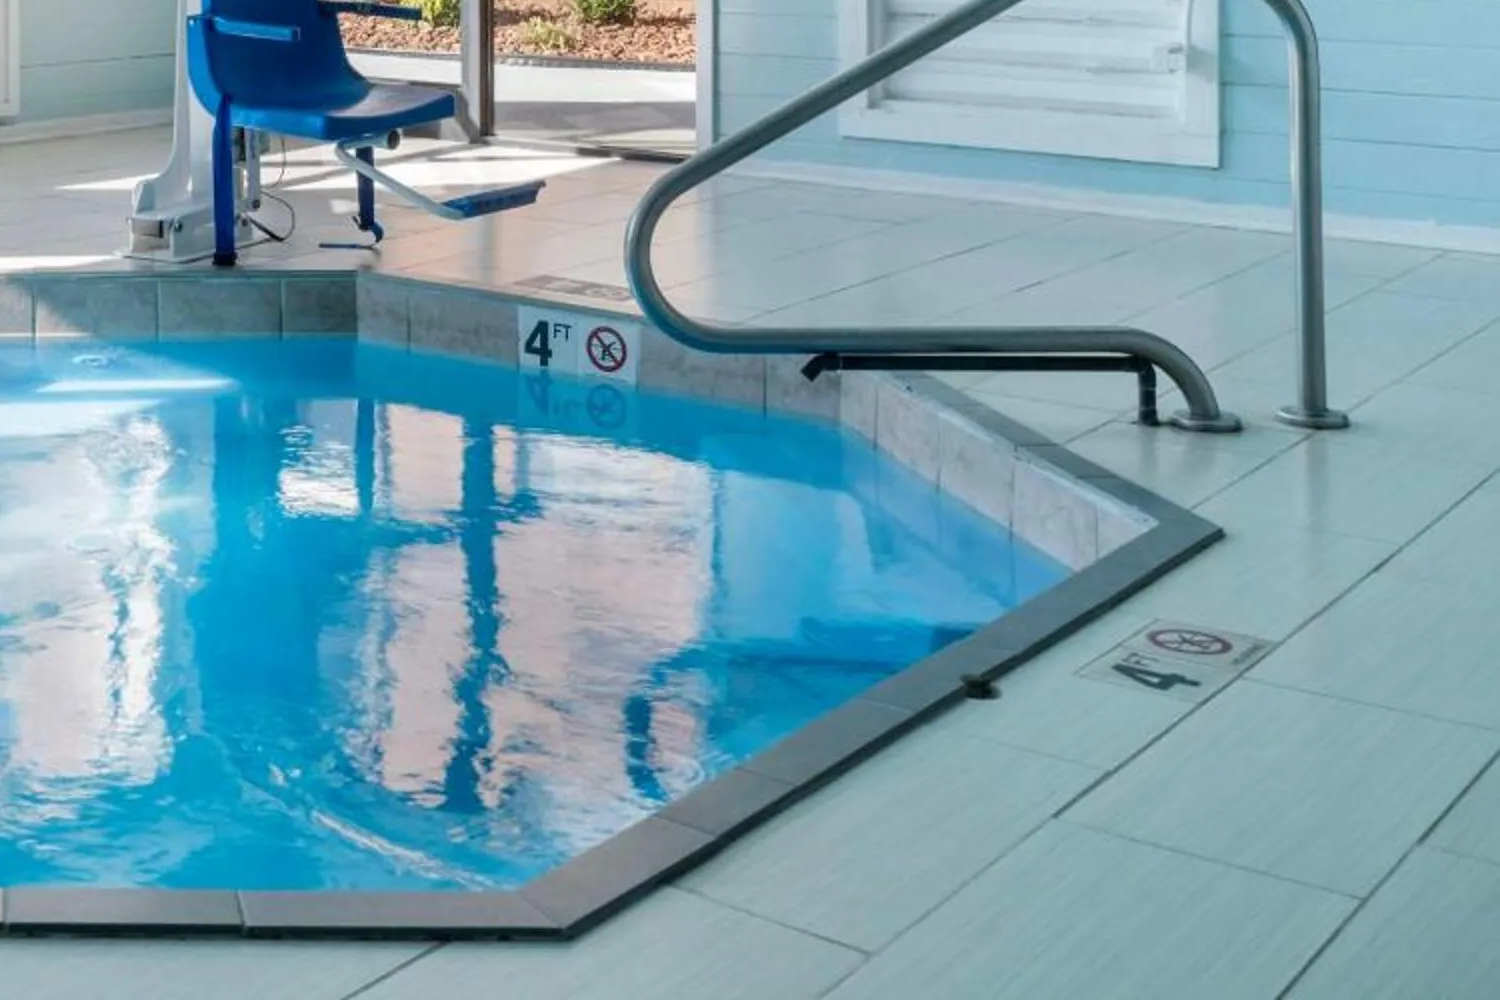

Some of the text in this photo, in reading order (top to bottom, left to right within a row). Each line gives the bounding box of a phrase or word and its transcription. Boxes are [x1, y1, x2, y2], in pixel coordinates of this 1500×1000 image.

[524, 320, 572, 367] 4 FT
[1112, 664, 1202, 691] 4
